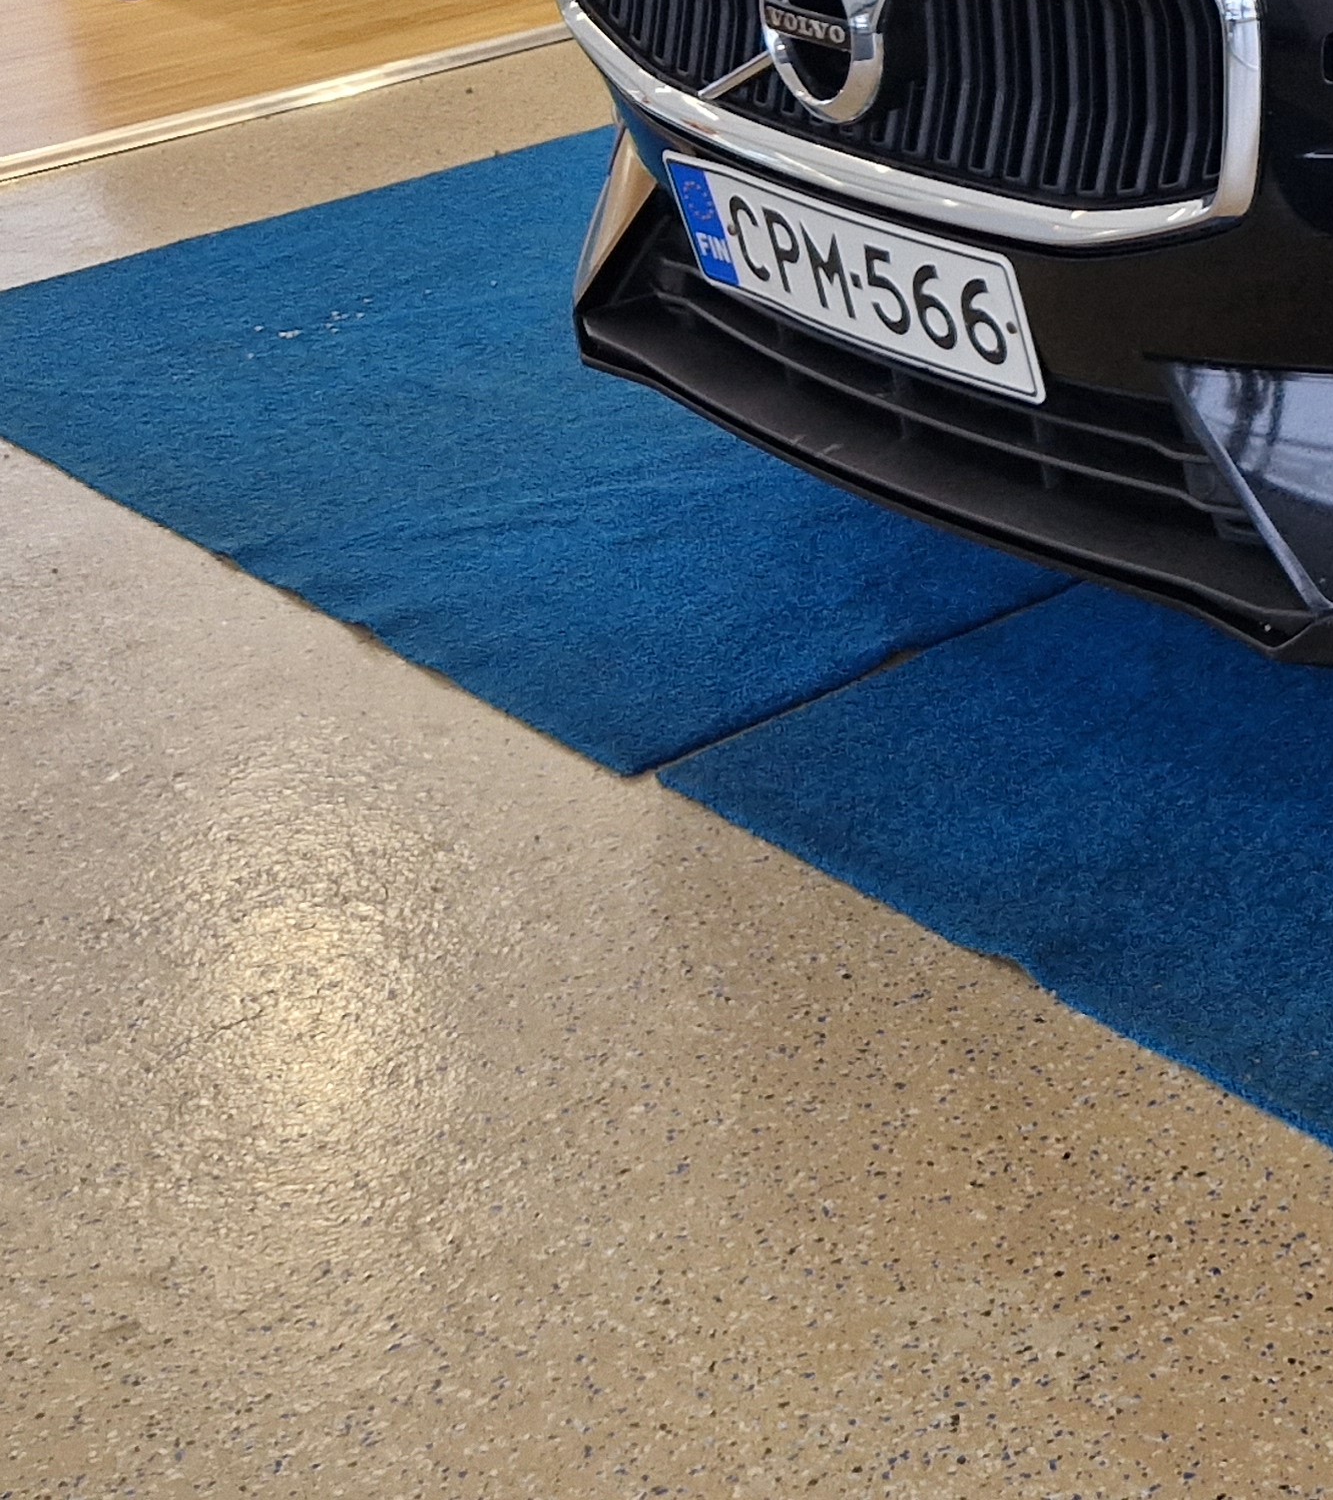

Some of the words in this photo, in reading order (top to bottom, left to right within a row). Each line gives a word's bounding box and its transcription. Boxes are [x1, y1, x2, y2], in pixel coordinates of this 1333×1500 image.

[765, 5, 846, 44] VOLVO
[694, 231, 733, 266] FIN
[728, 195, 1008, 366] CPM-566
